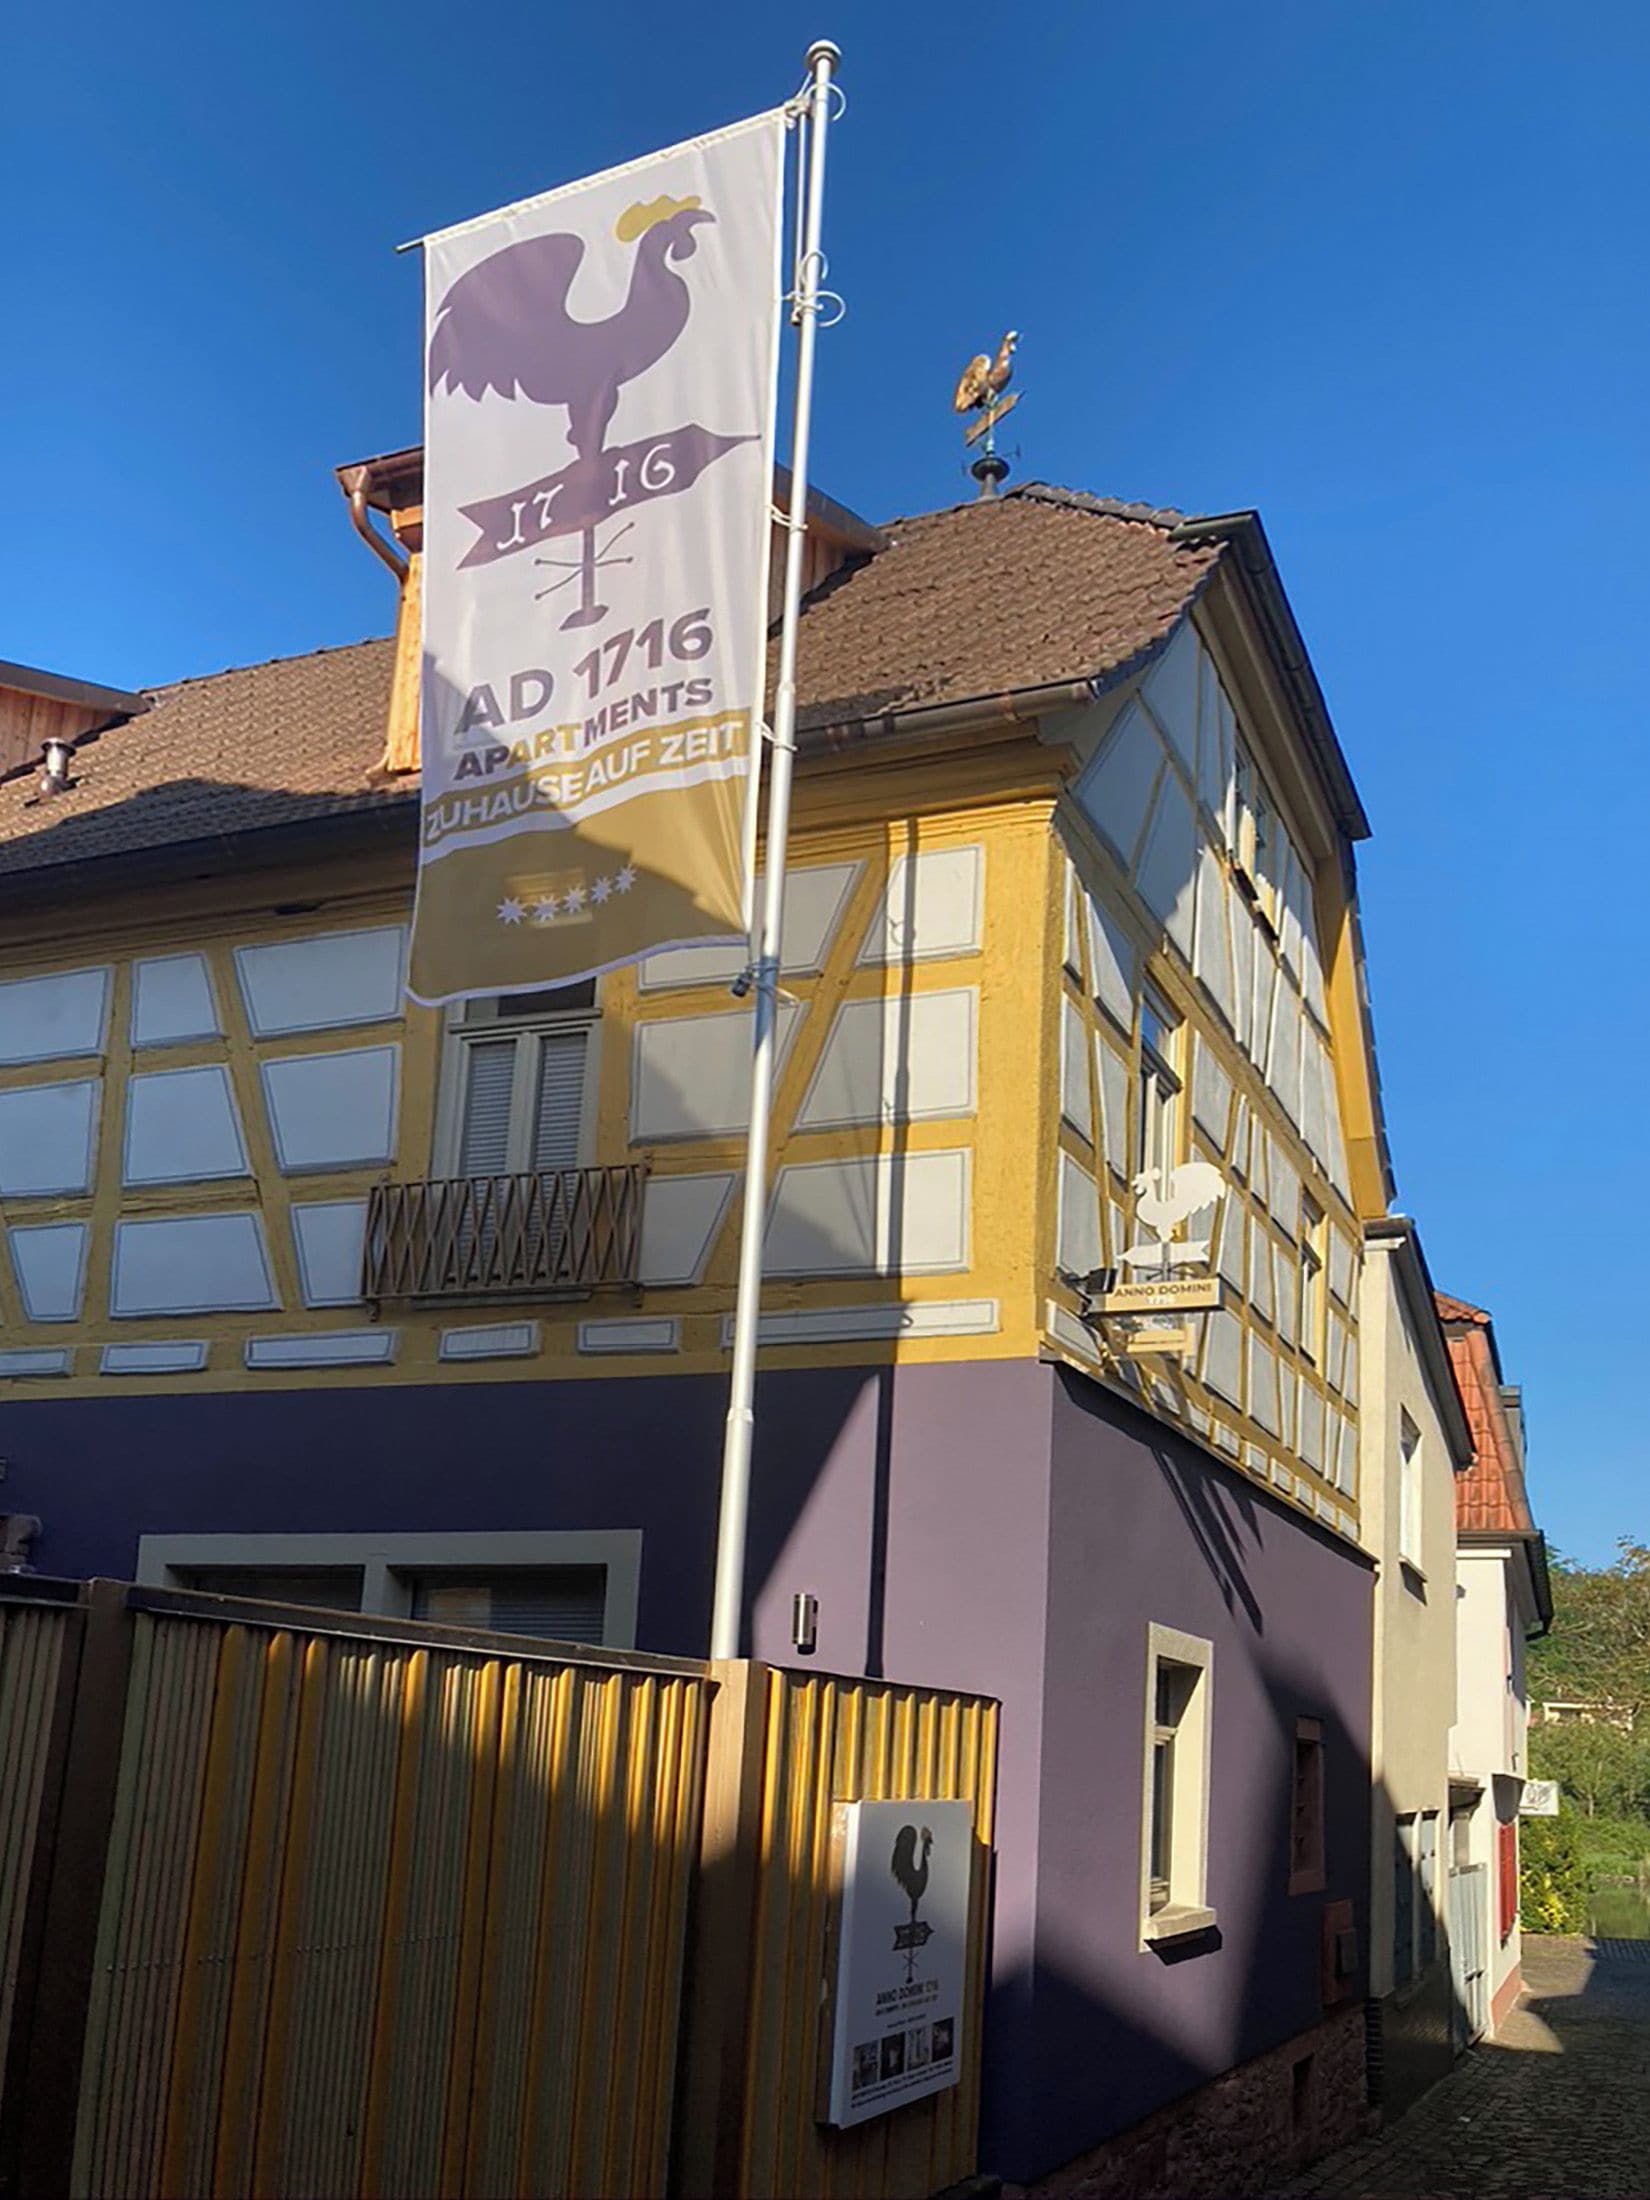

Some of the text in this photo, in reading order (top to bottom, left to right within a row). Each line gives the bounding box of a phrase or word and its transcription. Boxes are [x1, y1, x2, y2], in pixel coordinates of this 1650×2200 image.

[454, 608, 714, 735] AD 1716
[426, 721, 743, 839] ZUHAUSE AUF ZEIT
[454, 678, 713, 780] APARTMENTS
[1114, 1283, 1212, 1298] ANNO DOMINI
